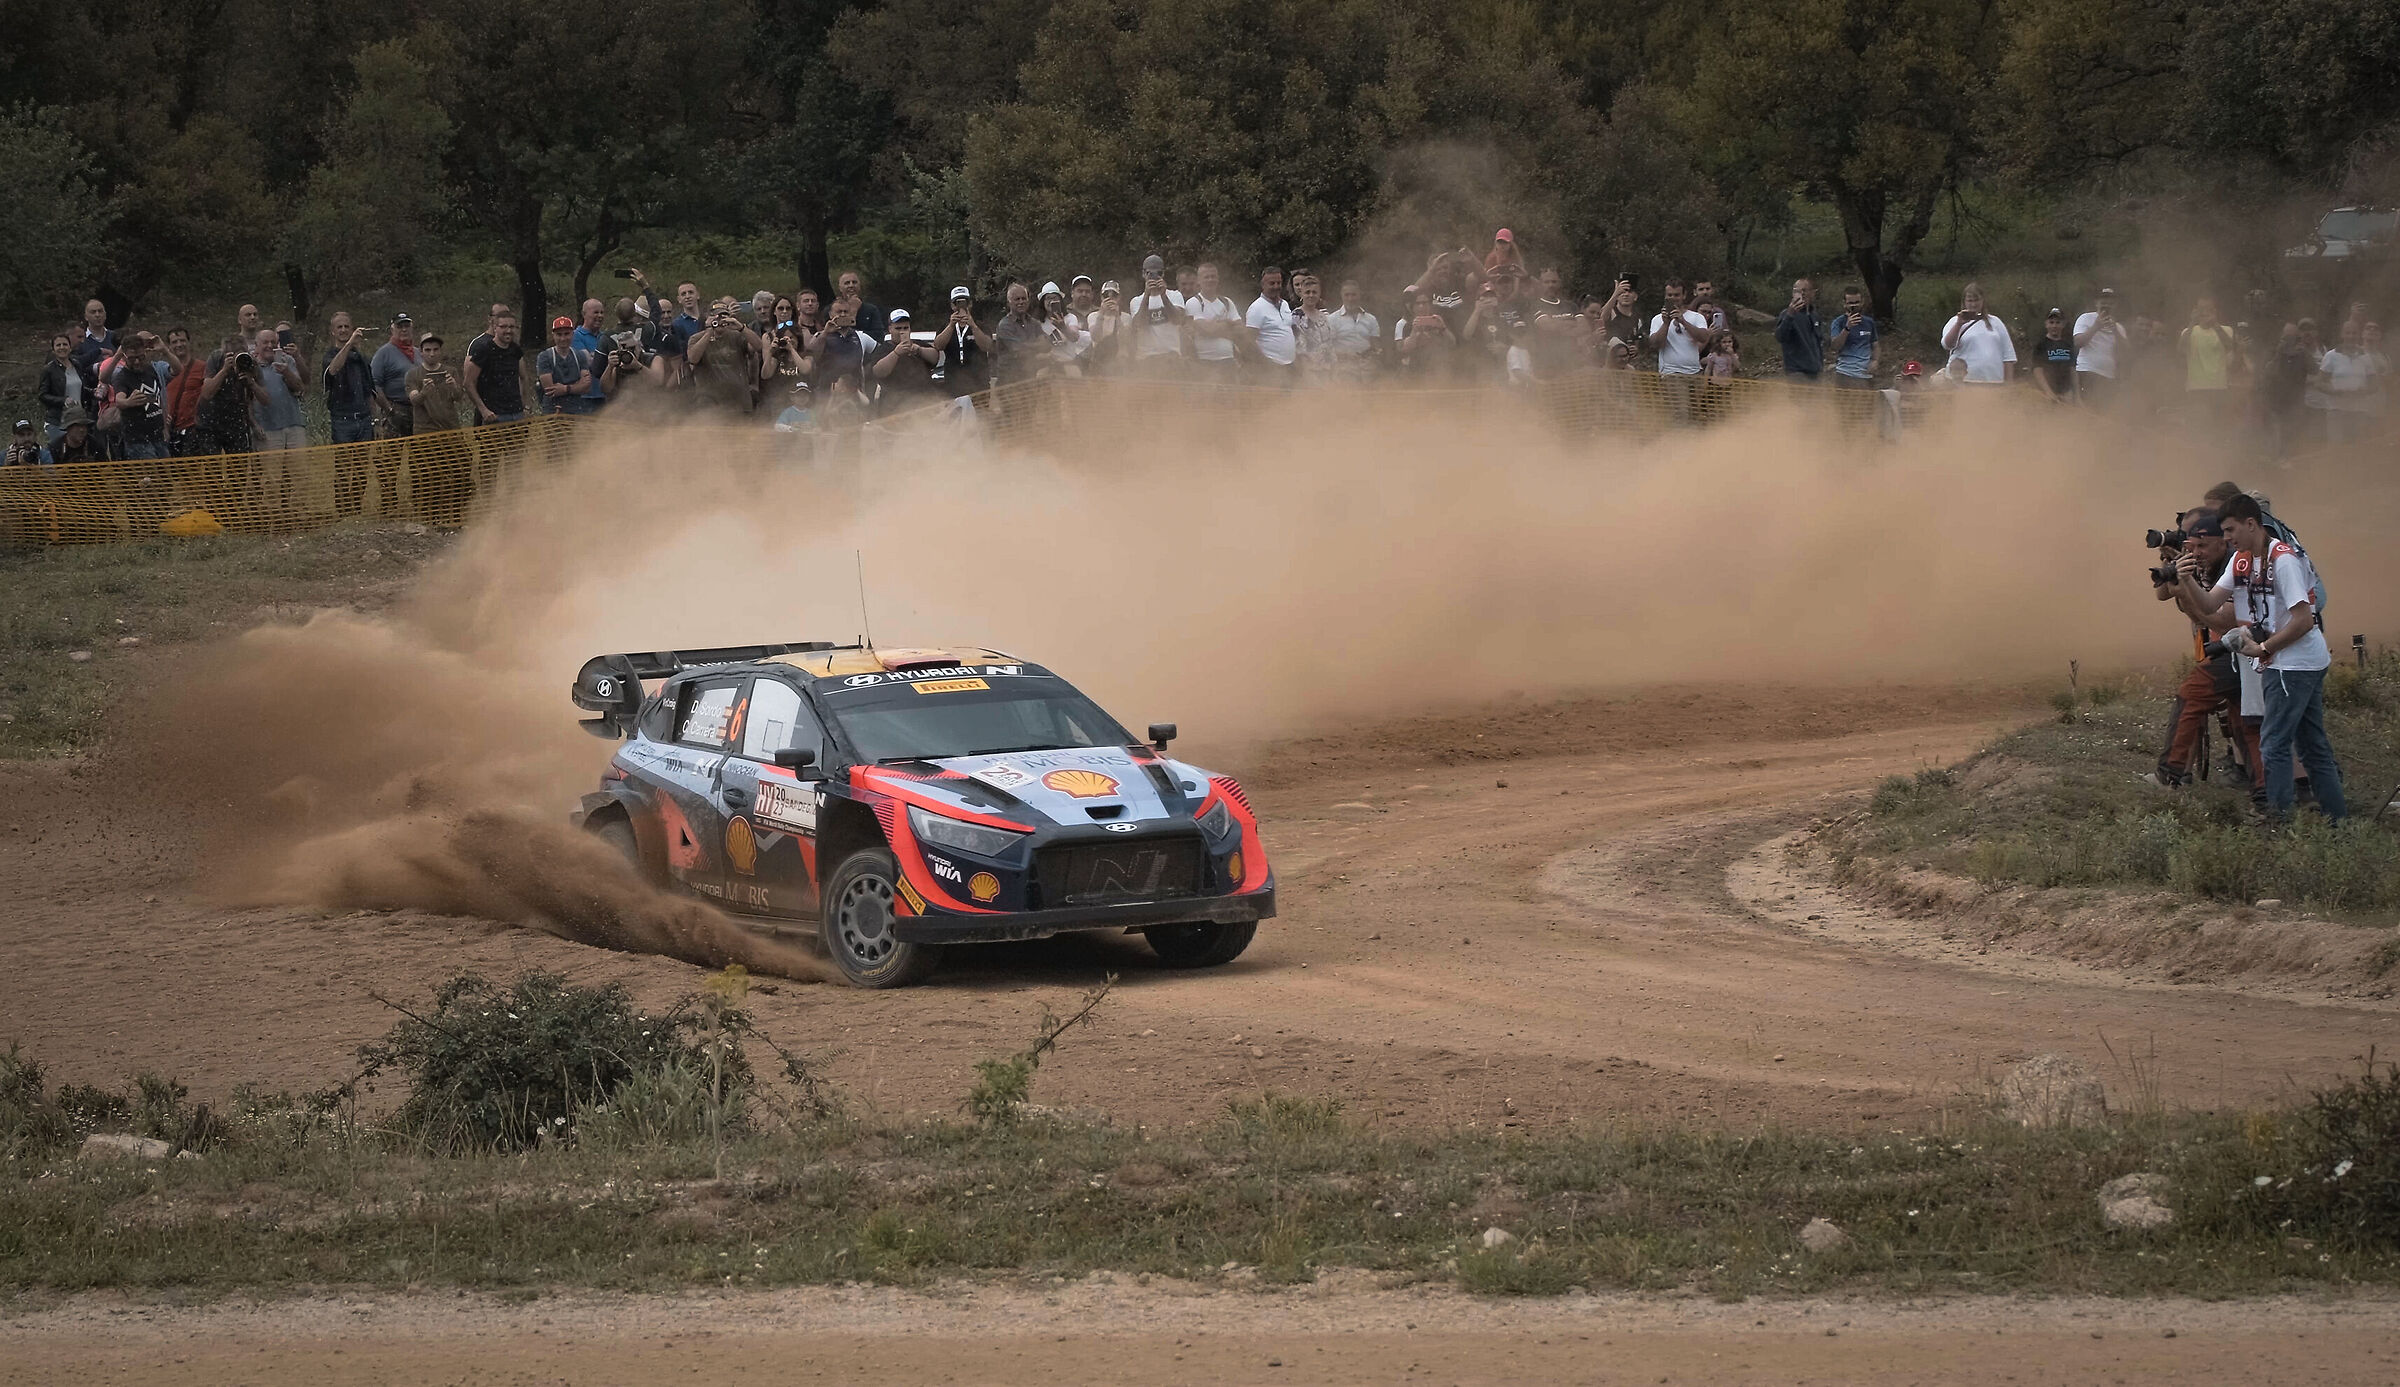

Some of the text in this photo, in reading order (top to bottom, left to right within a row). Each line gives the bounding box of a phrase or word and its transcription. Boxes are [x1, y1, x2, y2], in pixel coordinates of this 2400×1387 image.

[887, 666, 978, 681] HYUNDAI
[921, 681, 982, 691] PIRELLI
[729, 697, 747, 742] 6
[1021, 755, 1132, 769] MOBIS
[776, 786, 786, 802] 20
[814, 791, 827, 808] N
[773, 801, 785, 816] 23
[725, 882, 769, 909] MBIS
